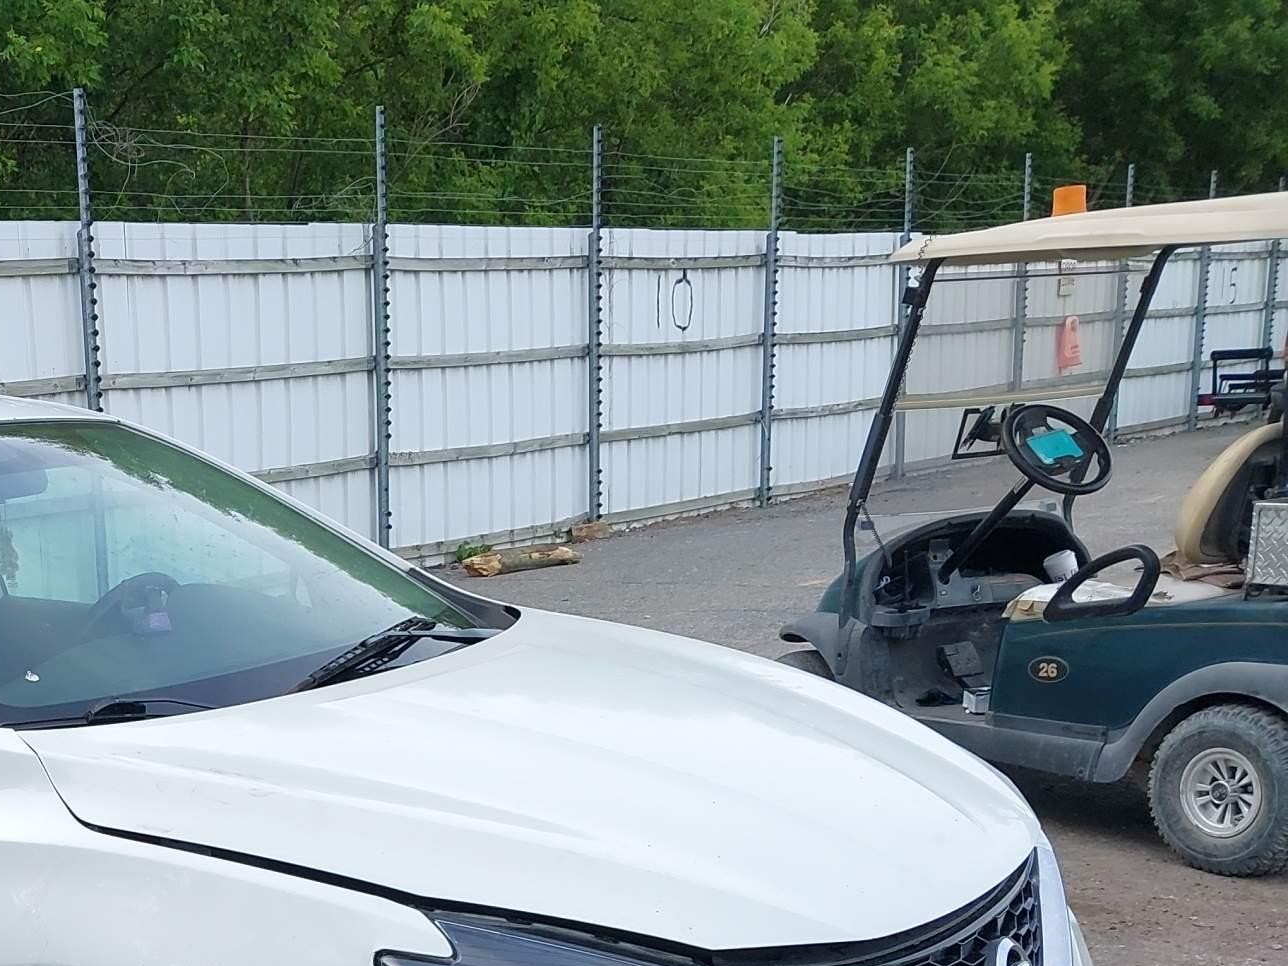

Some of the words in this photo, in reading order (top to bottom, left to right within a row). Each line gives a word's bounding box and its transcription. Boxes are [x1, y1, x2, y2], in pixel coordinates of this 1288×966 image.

[656, 272, 693, 333] 10
[1221, 266, 1238, 304] 15
[1038, 662, 1058, 678] 26
